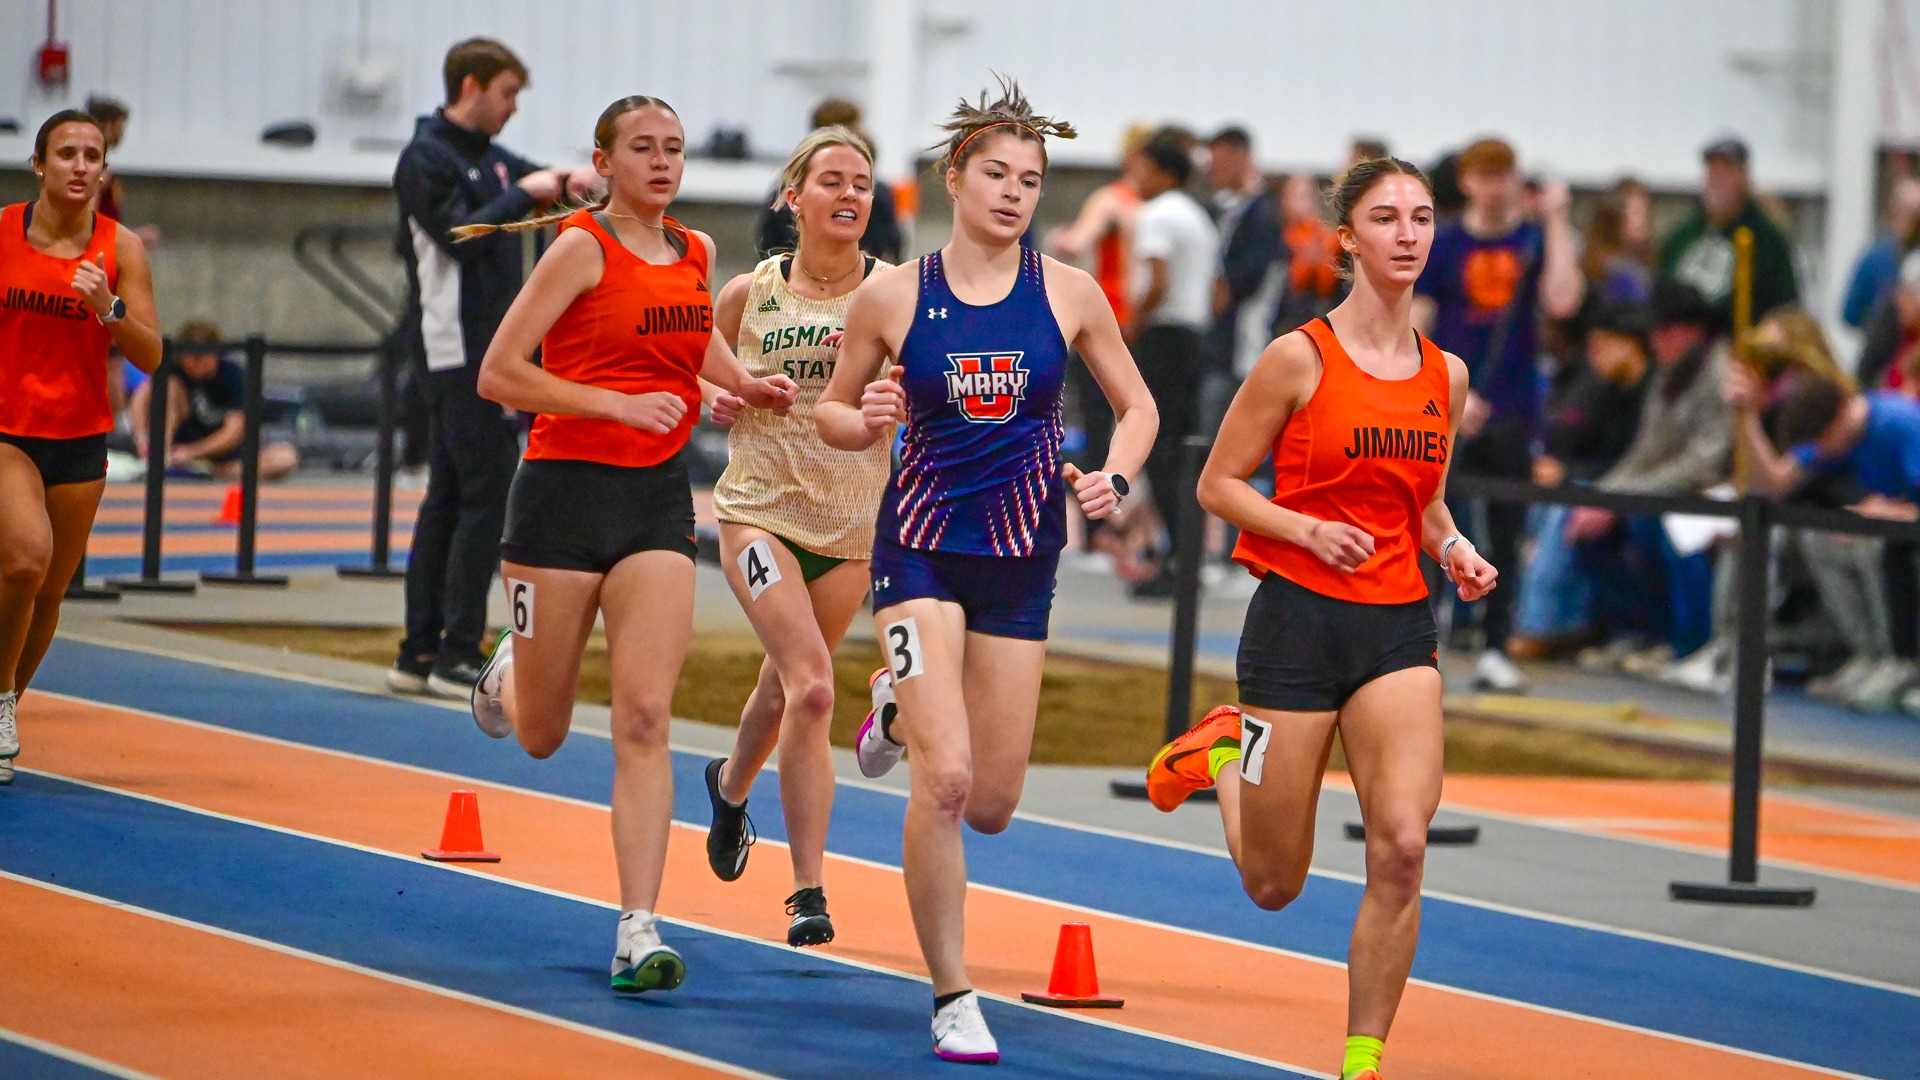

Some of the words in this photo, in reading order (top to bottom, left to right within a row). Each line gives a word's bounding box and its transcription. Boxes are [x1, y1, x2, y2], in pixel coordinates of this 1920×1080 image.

[3, 287, 89, 321] JIMMIES
[636, 305, 713, 335] JIMMIE
[758, 304, 780, 312] adidas
[951, 373, 1024, 399] MARY
[1344, 427, 1448, 465] JIMMIES
[748, 546, 769, 588] 4
[513, 583, 527, 633] 6
[889, 625, 912, 679] 3
[1242, 719, 1264, 775] 7
